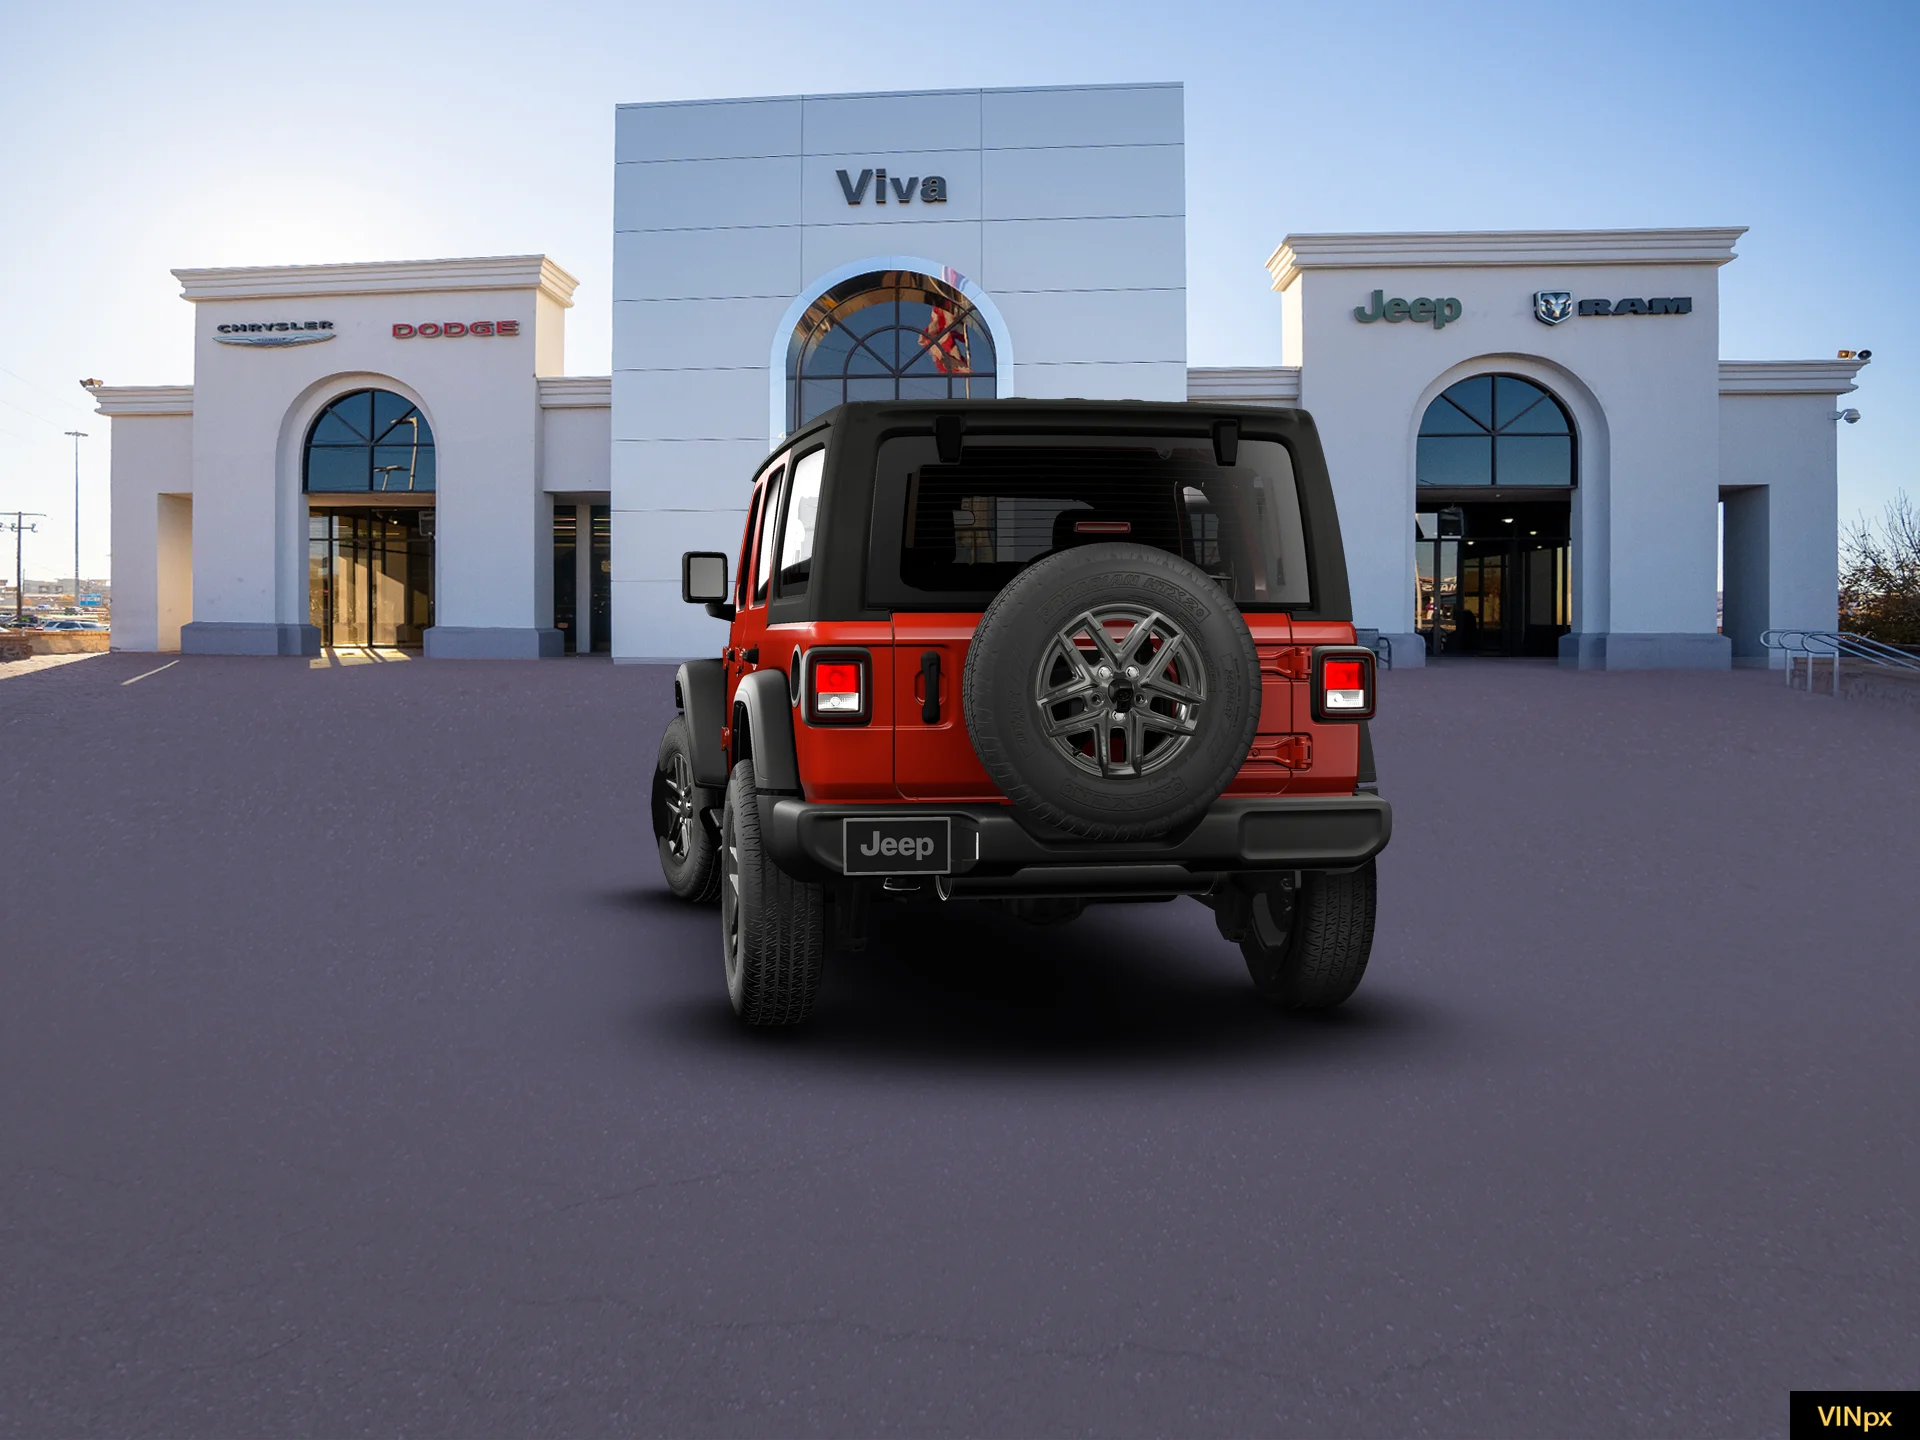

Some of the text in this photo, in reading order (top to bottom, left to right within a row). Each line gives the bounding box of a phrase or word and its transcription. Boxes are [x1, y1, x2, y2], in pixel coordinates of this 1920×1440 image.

[835, 168, 947, 205] Viva
[1354, 289, 1462, 329] Jeep
[1578, 297, 1692, 316] RAM
[217, 320, 334, 333] CHRYSLER
[392, 320, 520, 338] DODGE
[860, 830, 934, 861] Jeep
